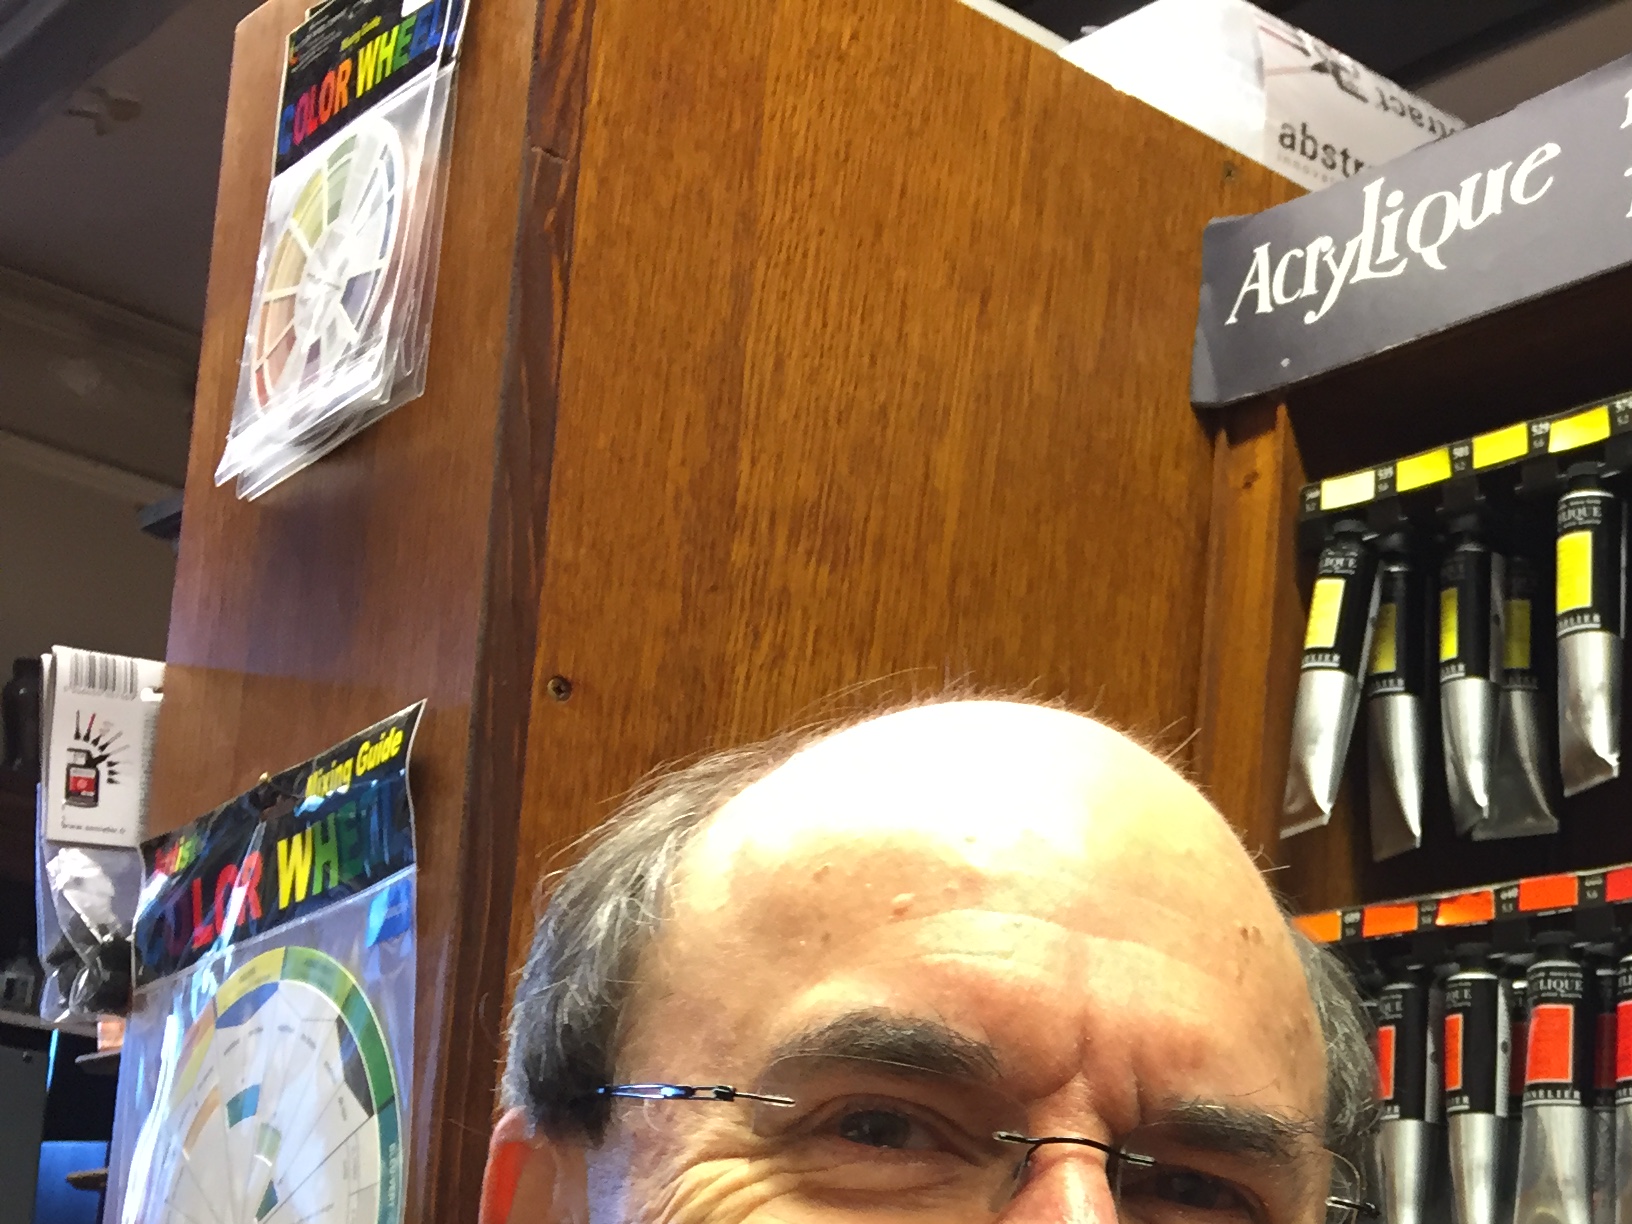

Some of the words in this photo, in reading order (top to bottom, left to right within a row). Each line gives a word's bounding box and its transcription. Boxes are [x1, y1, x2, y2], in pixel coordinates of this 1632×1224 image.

[279, 57, 354, 155] COLOR
[1279, 122, 1365, 178] abstr
[355, 726, 404, 777] Guide
